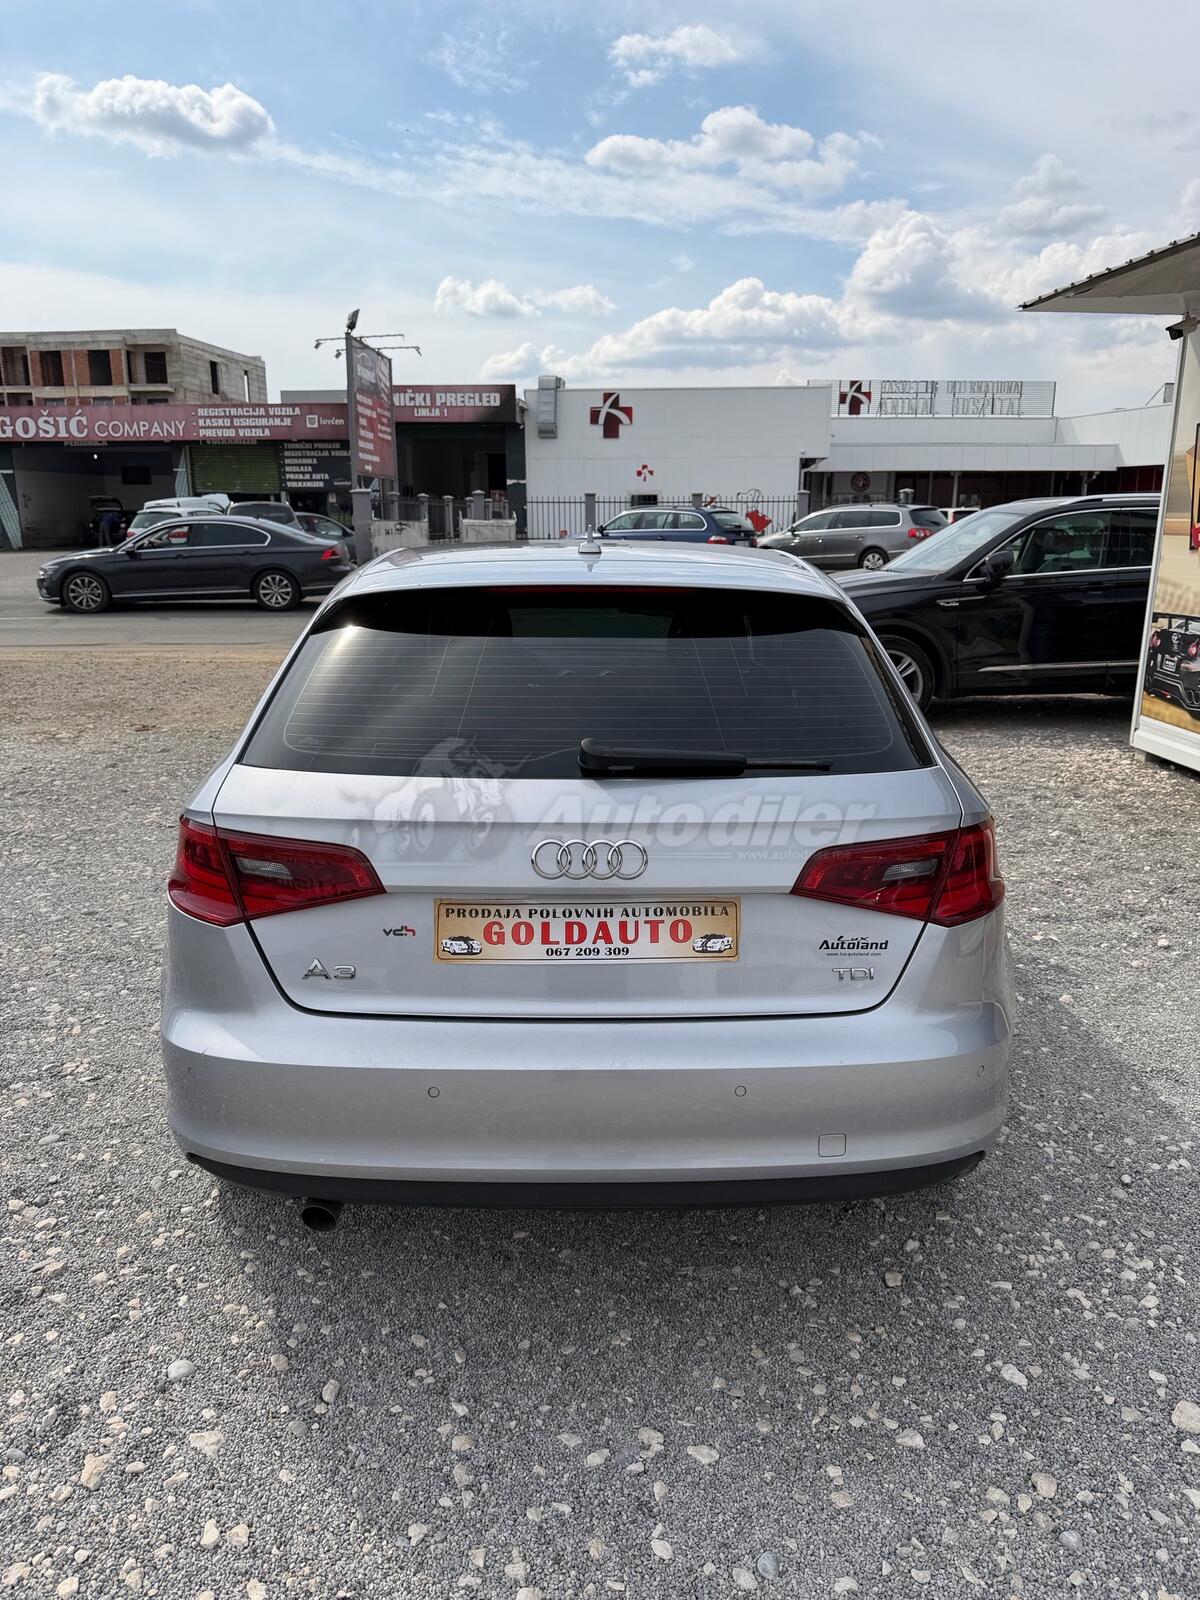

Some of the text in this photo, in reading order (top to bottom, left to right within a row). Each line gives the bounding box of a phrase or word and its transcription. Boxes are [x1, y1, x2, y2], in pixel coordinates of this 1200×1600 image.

[435, 392, 501, 407] PREGLED
[197, 407, 301, 417] REGISTRACIJA VOZILA
[414, 408, 448, 417] LINIJA 1
[198, 417, 292, 427] KASKO OSIGURANJE
[94, 420, 185, 437] COMPANY
[199, 428, 270, 437] PREVOD VOZILA
[445, 906, 730, 919] PRODAJA POLOVNIH AUTOMOBILA
[482, 918, 693, 946] GOLDAUTO
[818, 939, 889, 950] Autoland
[545, 946, 630, 957] 067 209 309
[301, 957, 357, 981] A3
[831, 967, 875, 982] TDI
